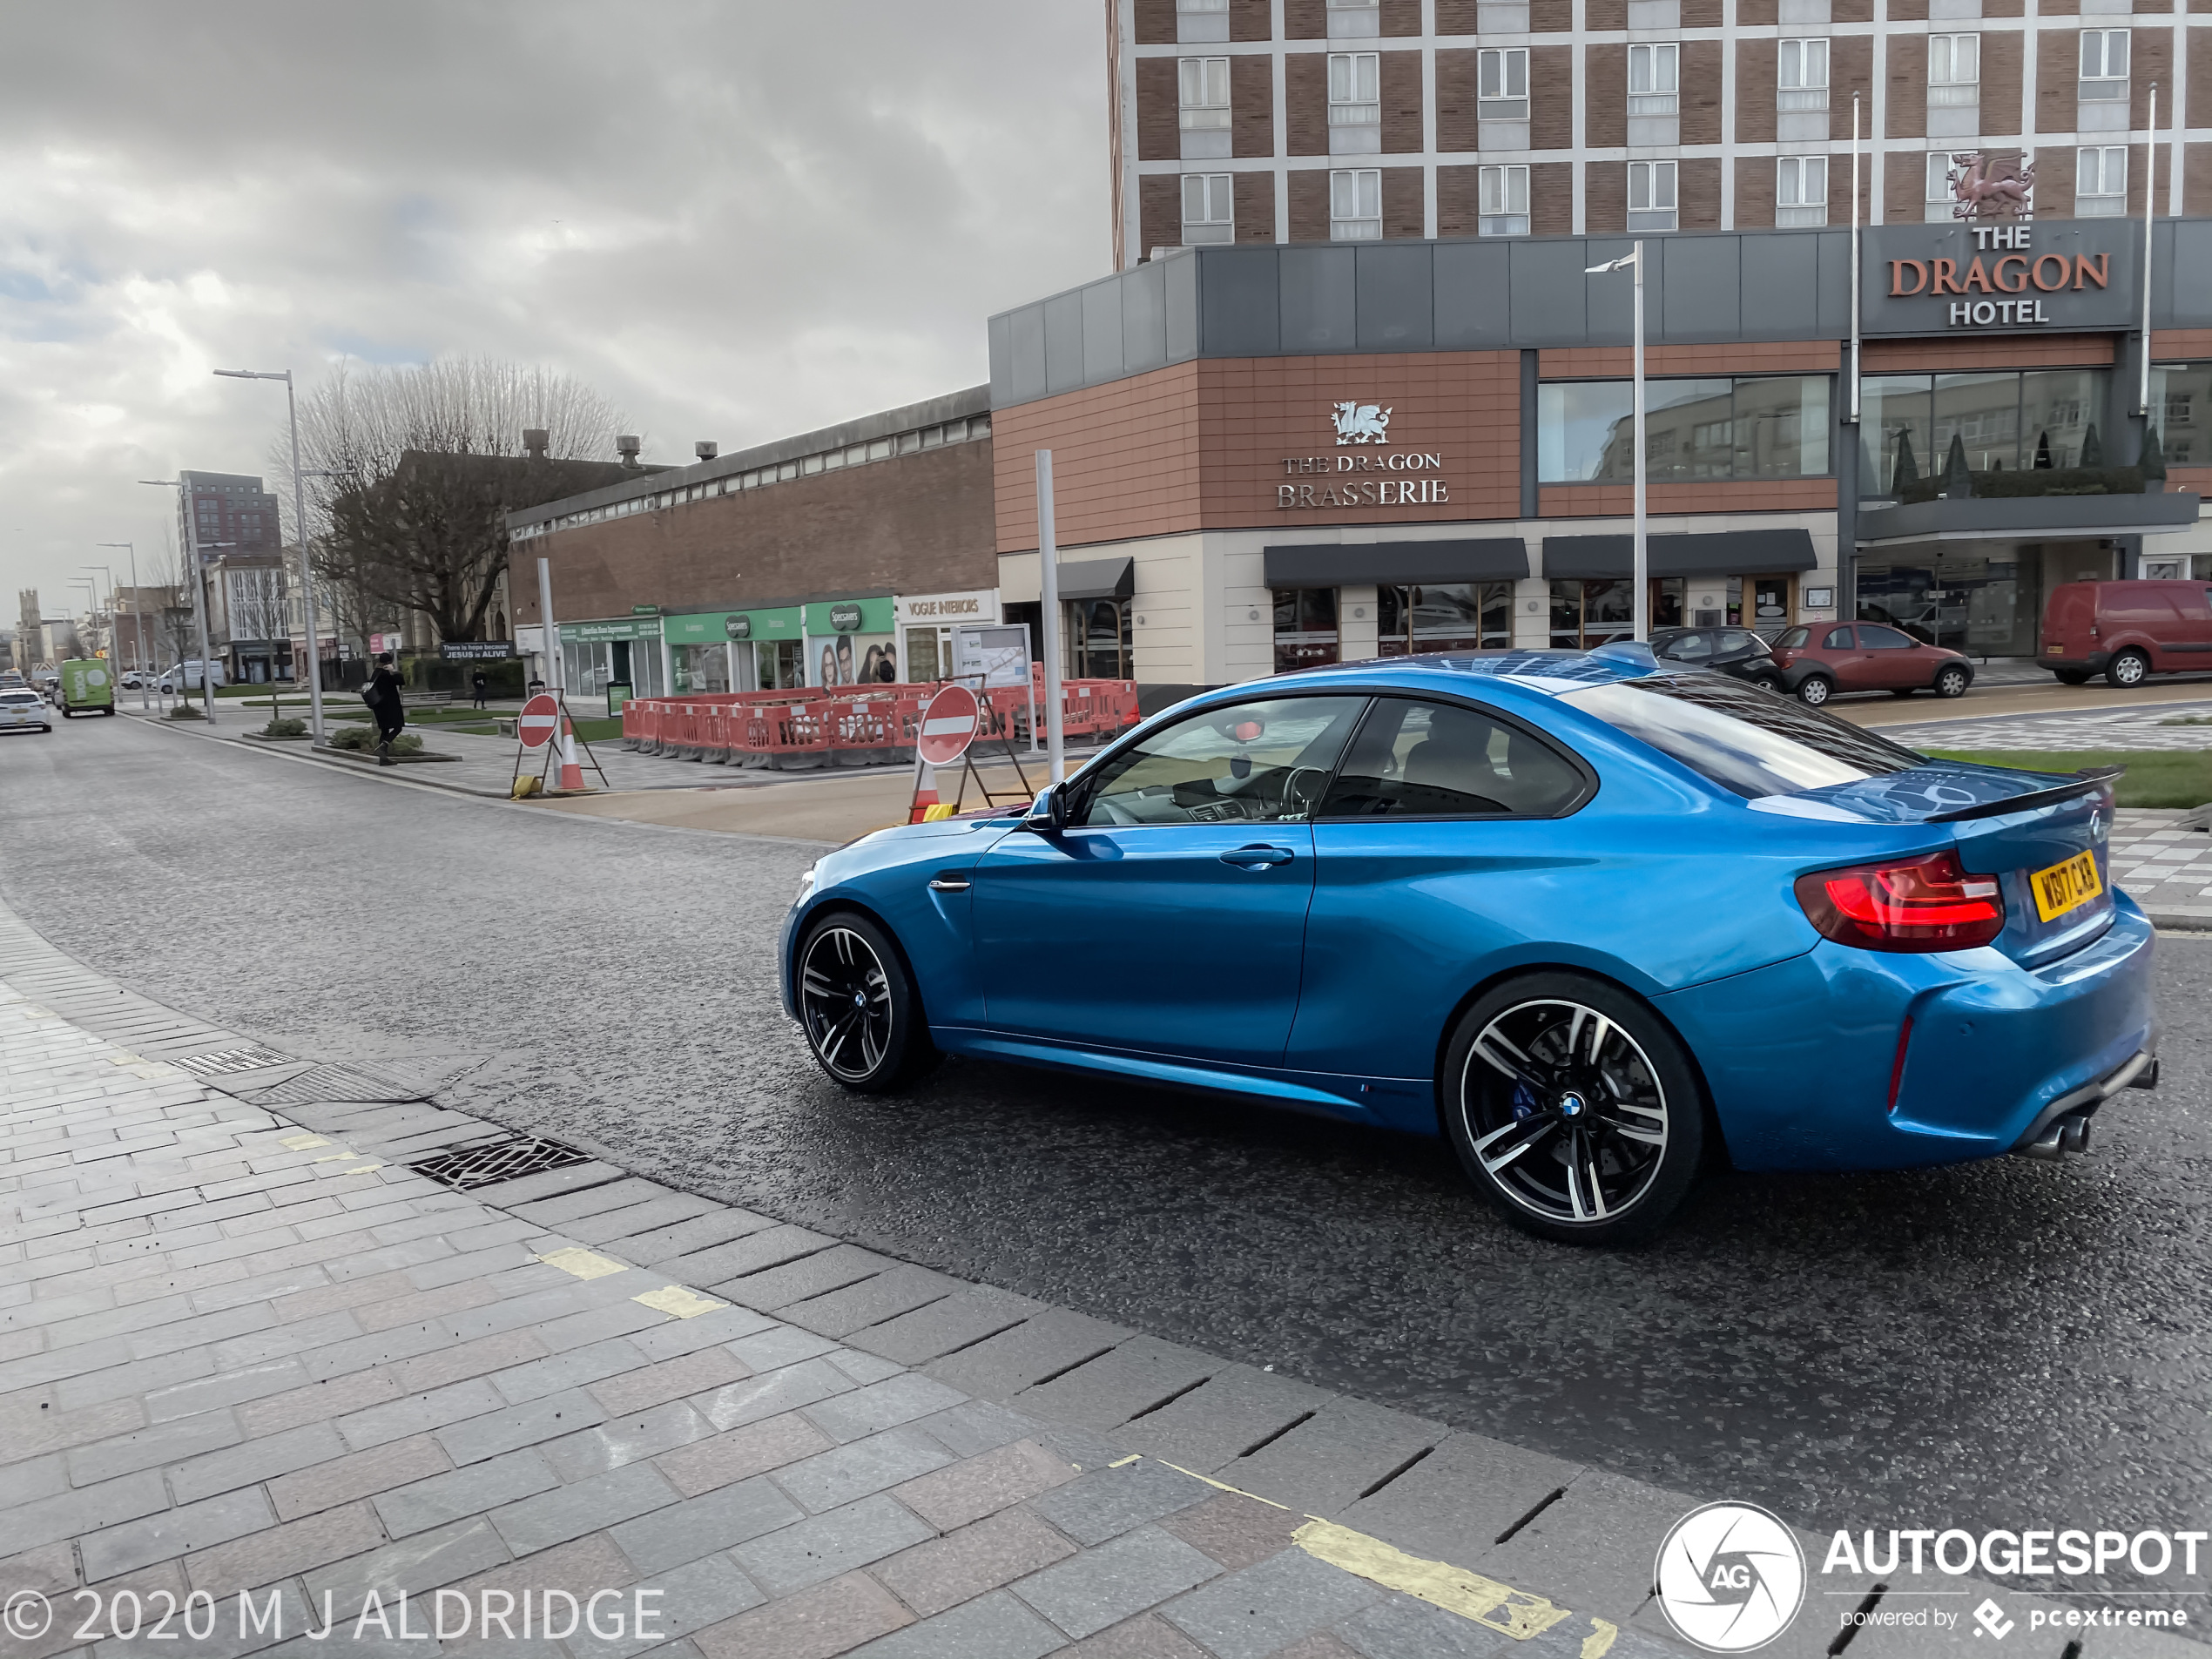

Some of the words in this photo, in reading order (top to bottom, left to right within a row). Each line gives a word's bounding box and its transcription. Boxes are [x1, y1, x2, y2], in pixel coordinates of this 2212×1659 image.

[1973, 226, 2031, 250] THE
[1888, 253, 2111, 297] DRAGON
[1949, 300, 2050, 326] HOTEL
[1282, 456, 1330, 475] THE
[1337, 452, 1442, 473] DRAGON
[1275, 479, 1450, 509] BRASSERIE
[831, 611, 858, 623] Specsavers
[908, 602, 937, 616] VOGUE
[939, 598, 979, 614] INTERIORS
[726, 621, 748, 631] Specsavers
[73, 670, 87, 700] YODEL
